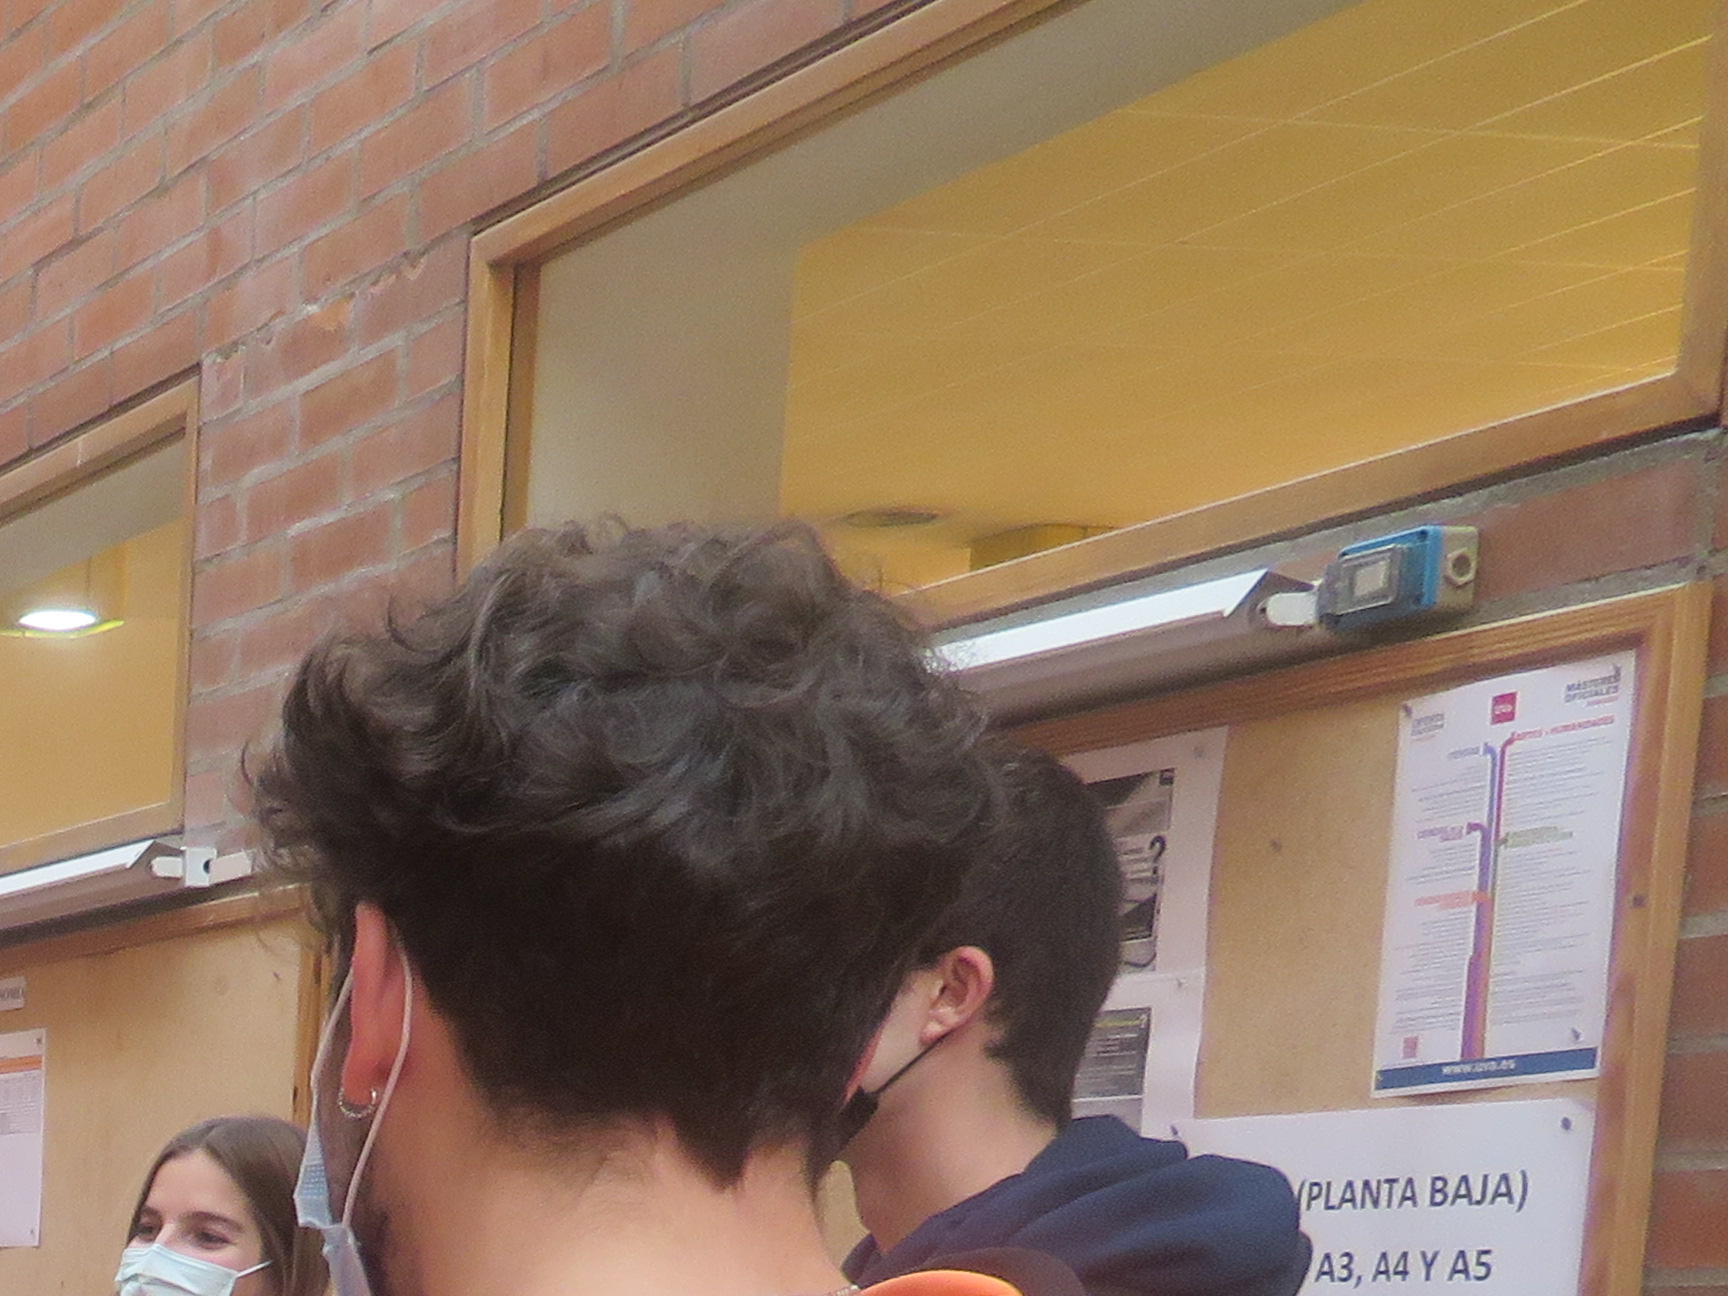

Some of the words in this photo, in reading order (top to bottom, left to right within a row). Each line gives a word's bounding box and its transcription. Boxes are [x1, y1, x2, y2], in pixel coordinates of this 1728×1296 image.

[1428, 1168, 1529, 1214] BAJA)
[1313, 1250, 1363, 1289] A3,
[1370, 1250, 1411, 1284] A4
[1418, 1249, 1441, 1283] Y
[1446, 1248, 1494, 1282] A5
